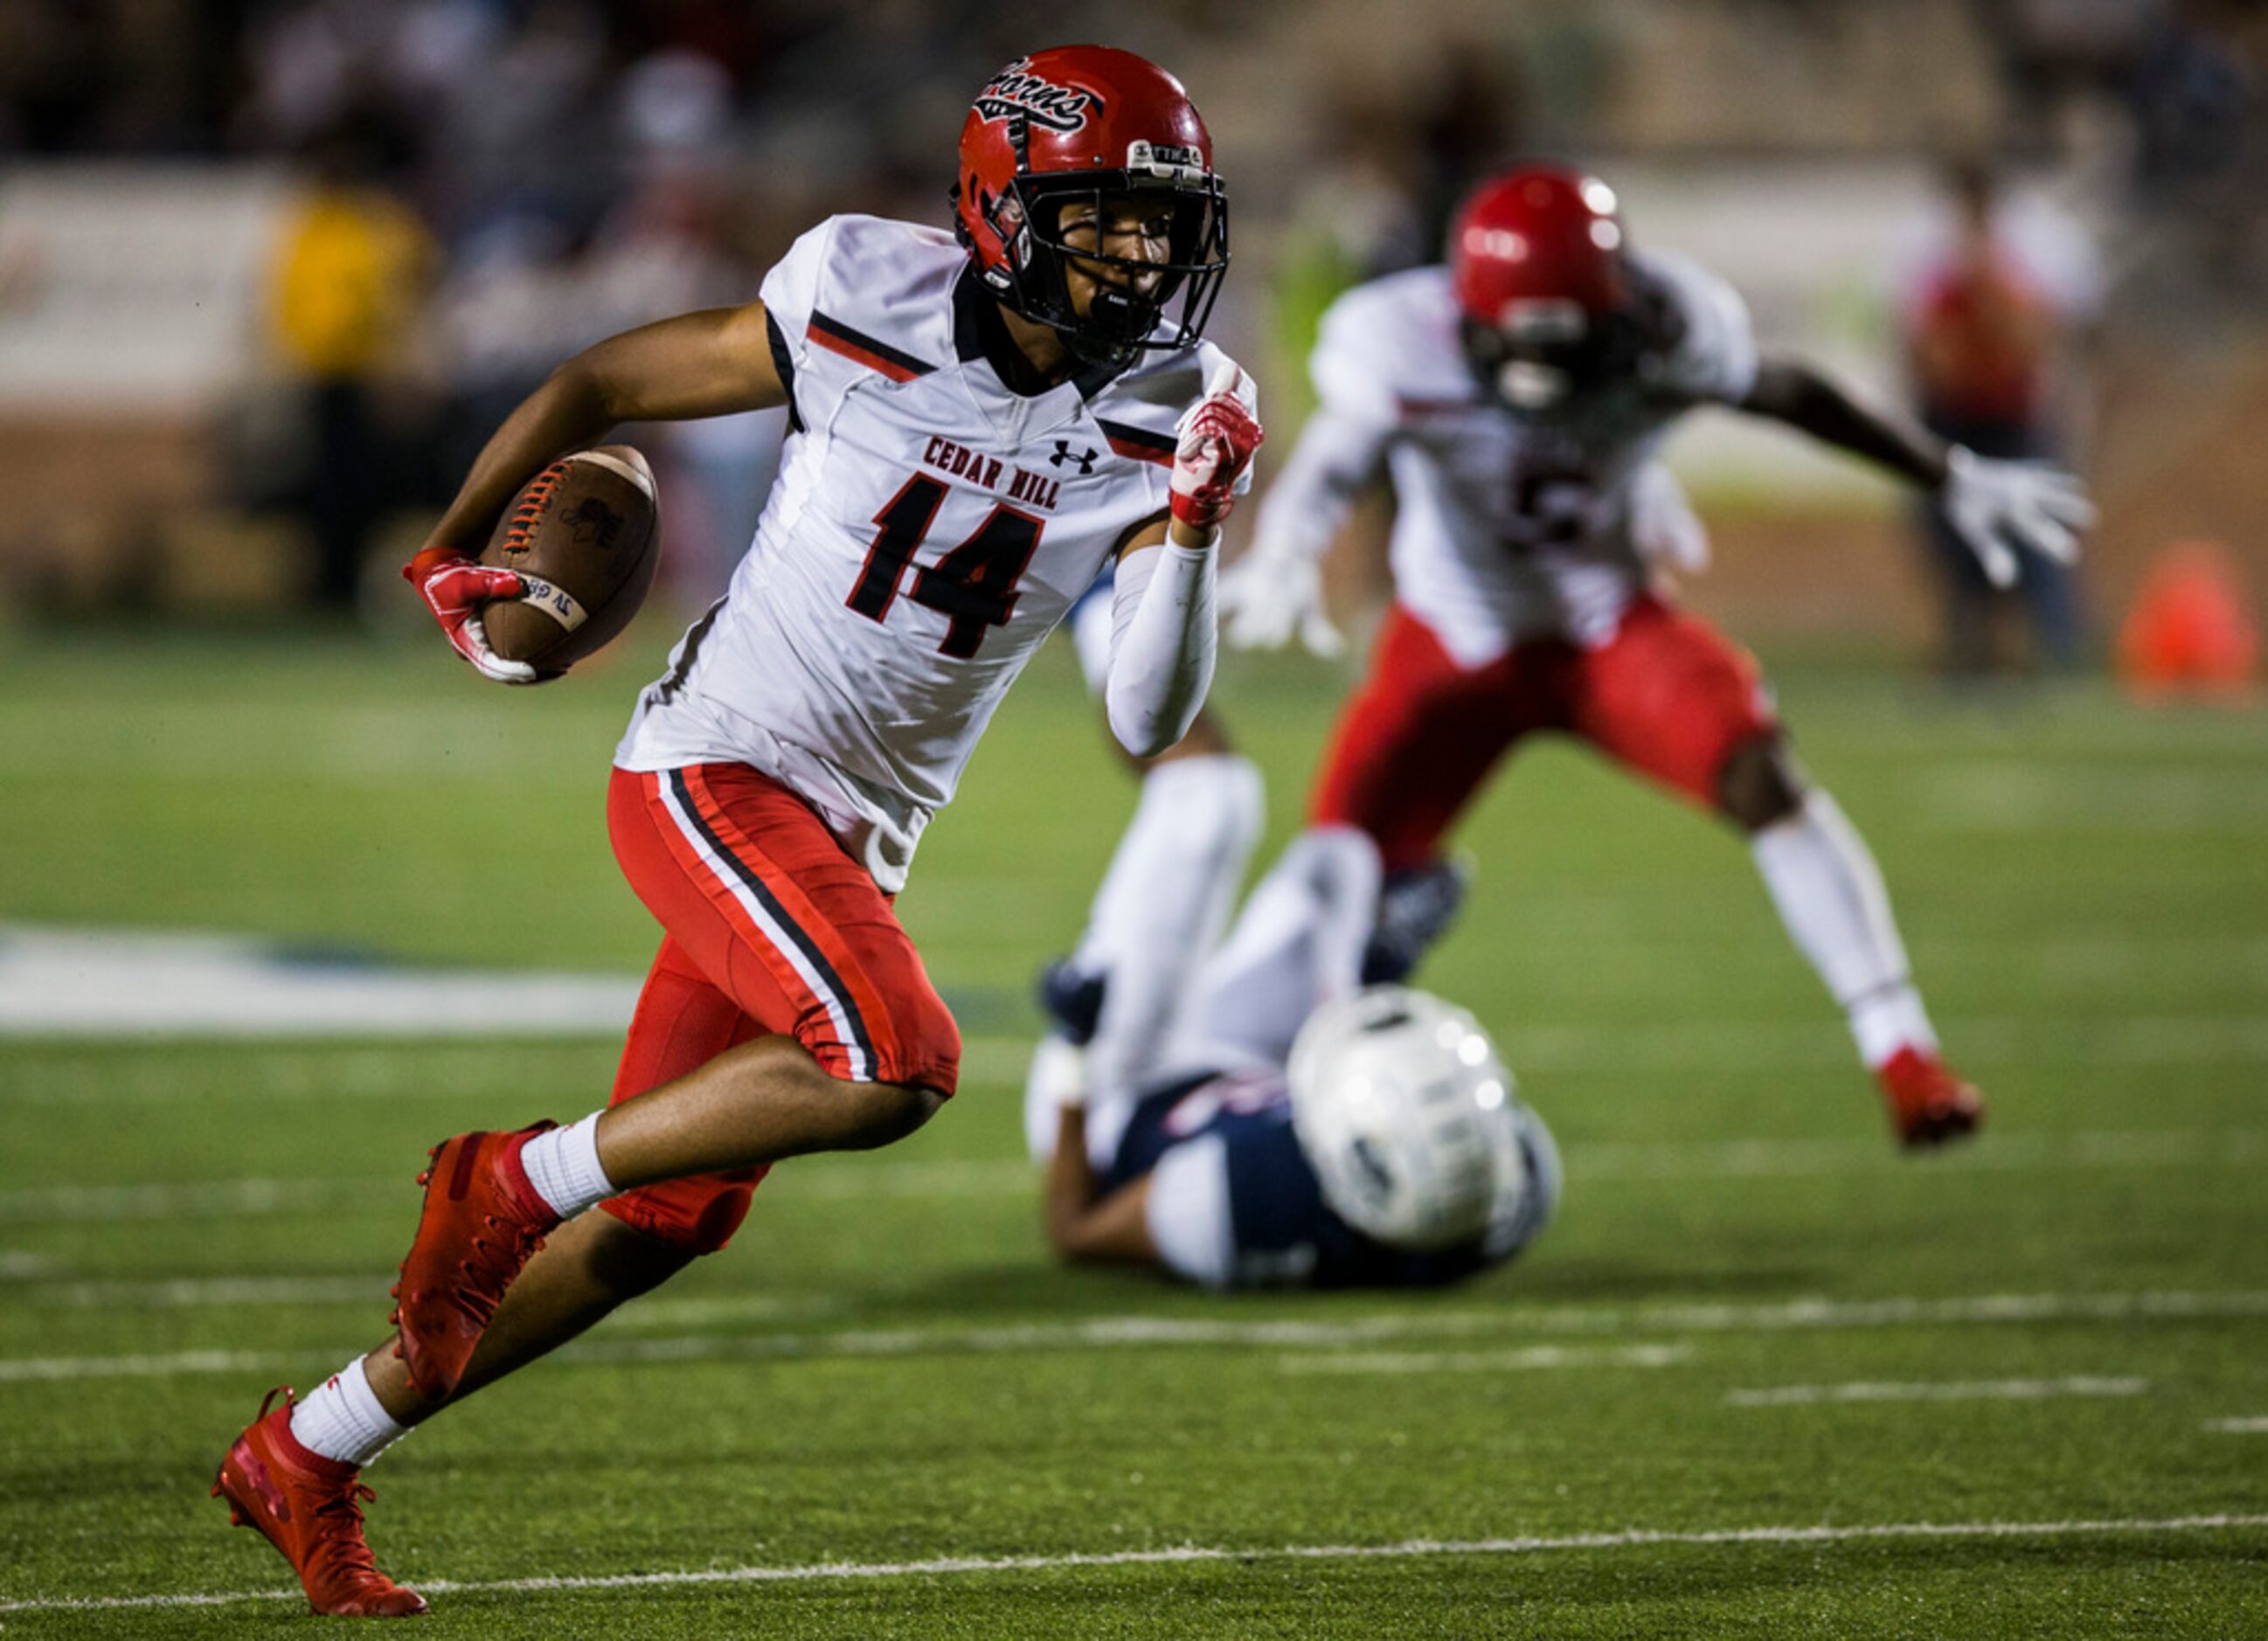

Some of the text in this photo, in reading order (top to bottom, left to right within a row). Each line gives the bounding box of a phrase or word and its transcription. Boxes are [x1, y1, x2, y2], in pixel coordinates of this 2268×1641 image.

[923, 436, 1060, 509] CEDAR HILL
[844, 470, 1046, 660] 14
